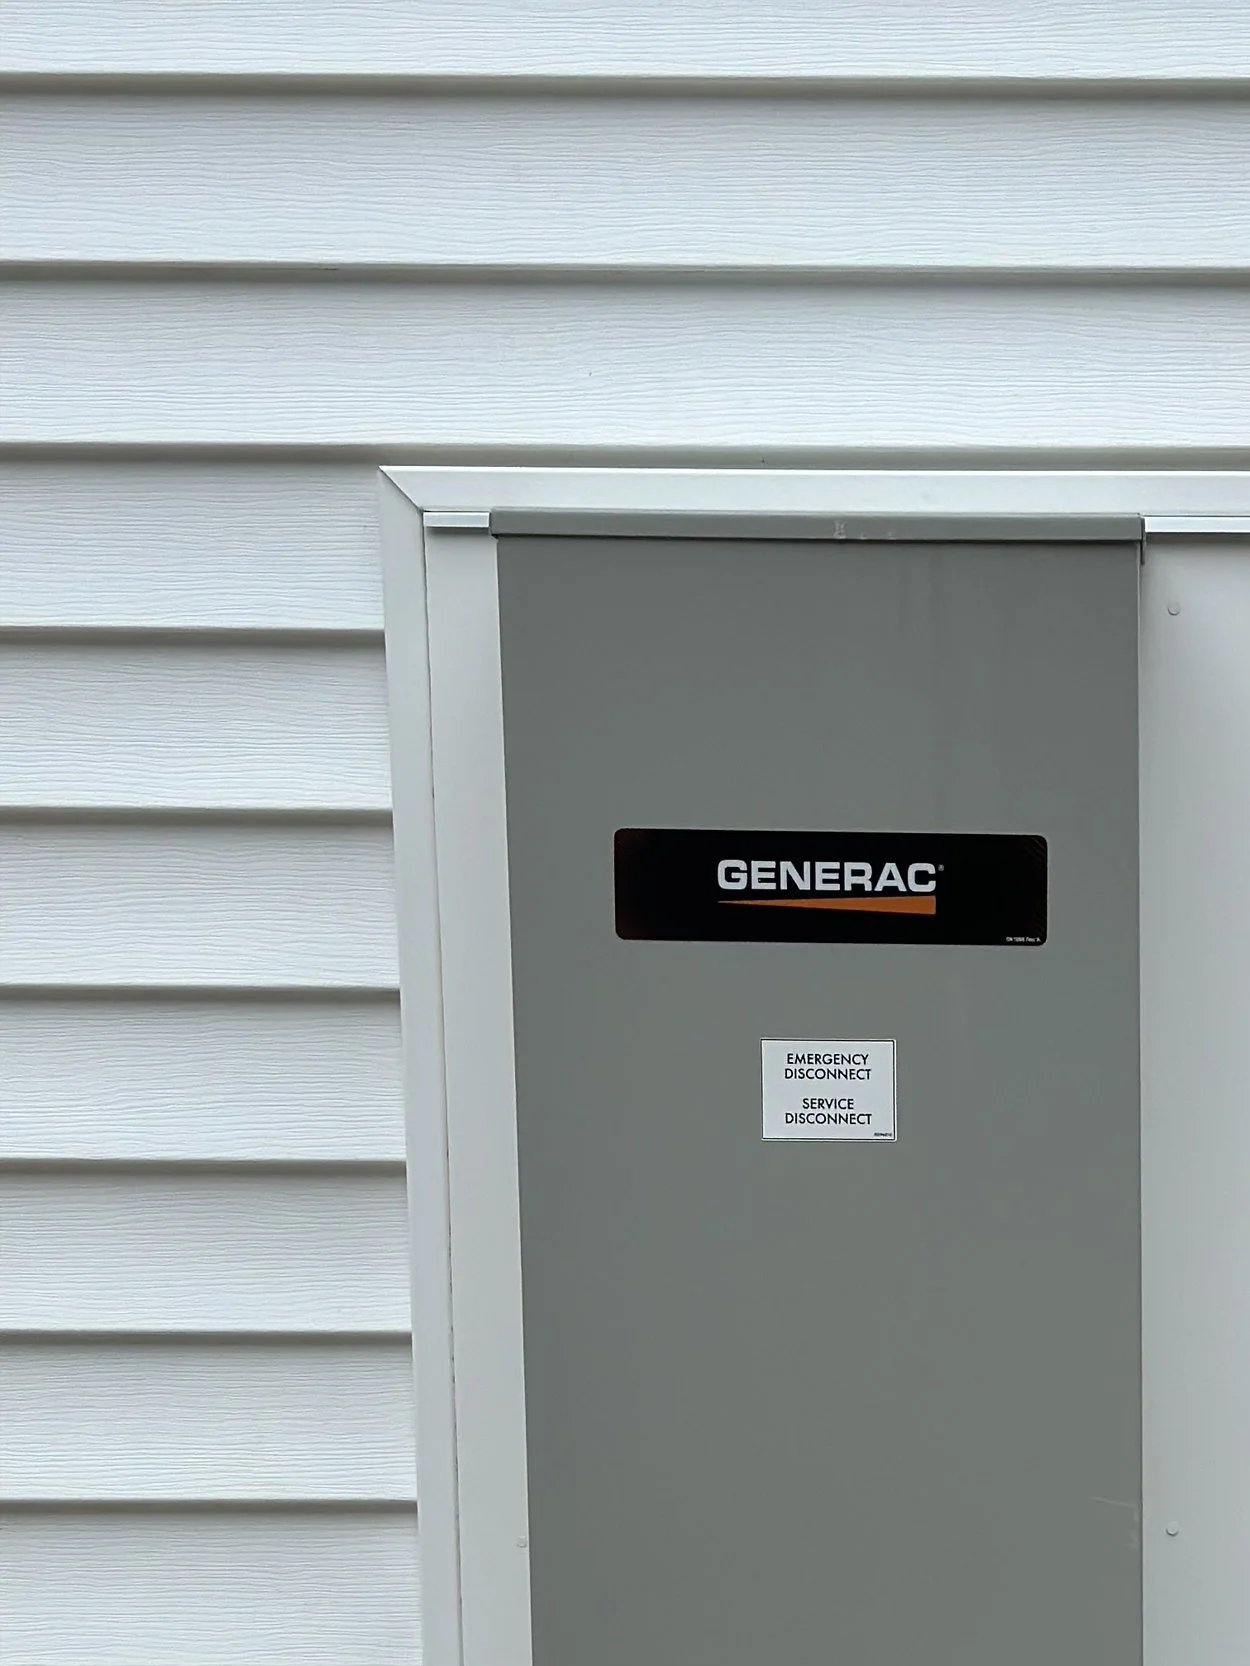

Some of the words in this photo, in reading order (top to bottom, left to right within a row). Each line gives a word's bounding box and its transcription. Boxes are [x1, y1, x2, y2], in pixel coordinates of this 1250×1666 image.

[717, 859, 937, 893] GENERAC
[787, 1053, 869, 1065] EMERGENCY
[784, 1068, 872, 1080] DISCONNECT
[802, 1098, 854, 1110] SERVICE
[785, 1113, 872, 1125] DISCONNECT
